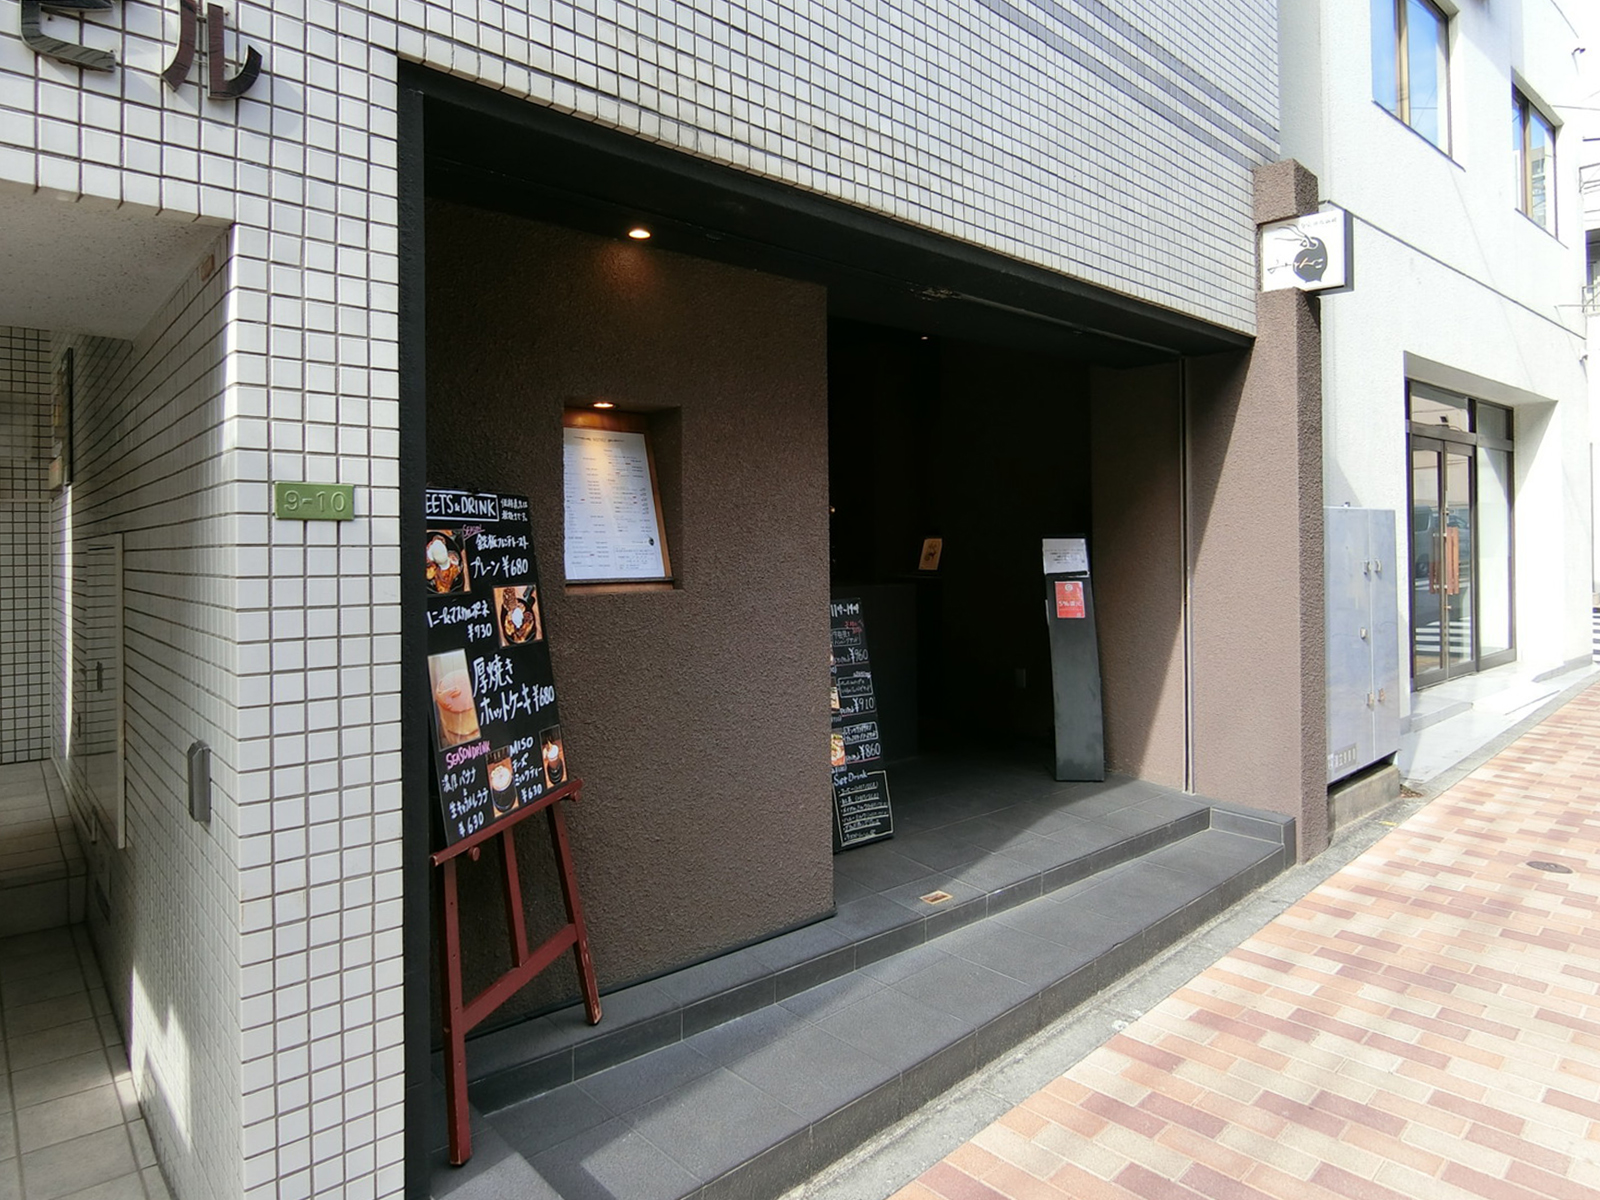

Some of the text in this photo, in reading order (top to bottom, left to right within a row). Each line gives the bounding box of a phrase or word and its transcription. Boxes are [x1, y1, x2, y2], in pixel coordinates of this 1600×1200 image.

[283, 489, 346, 513] 9-10
[470, 555, 528, 579] プレーン ¥680
[467, 623, 492, 643] ¥730
[473, 654, 514, 698] 厚焼き
[480, 683, 555, 726] ホットケーキ ¥680
[509, 736, 534, 758] MISO
[512, 752, 529, 773] チーズ
[521, 783, 543, 803] ¥630
[458, 811, 485, 838] ¥630
